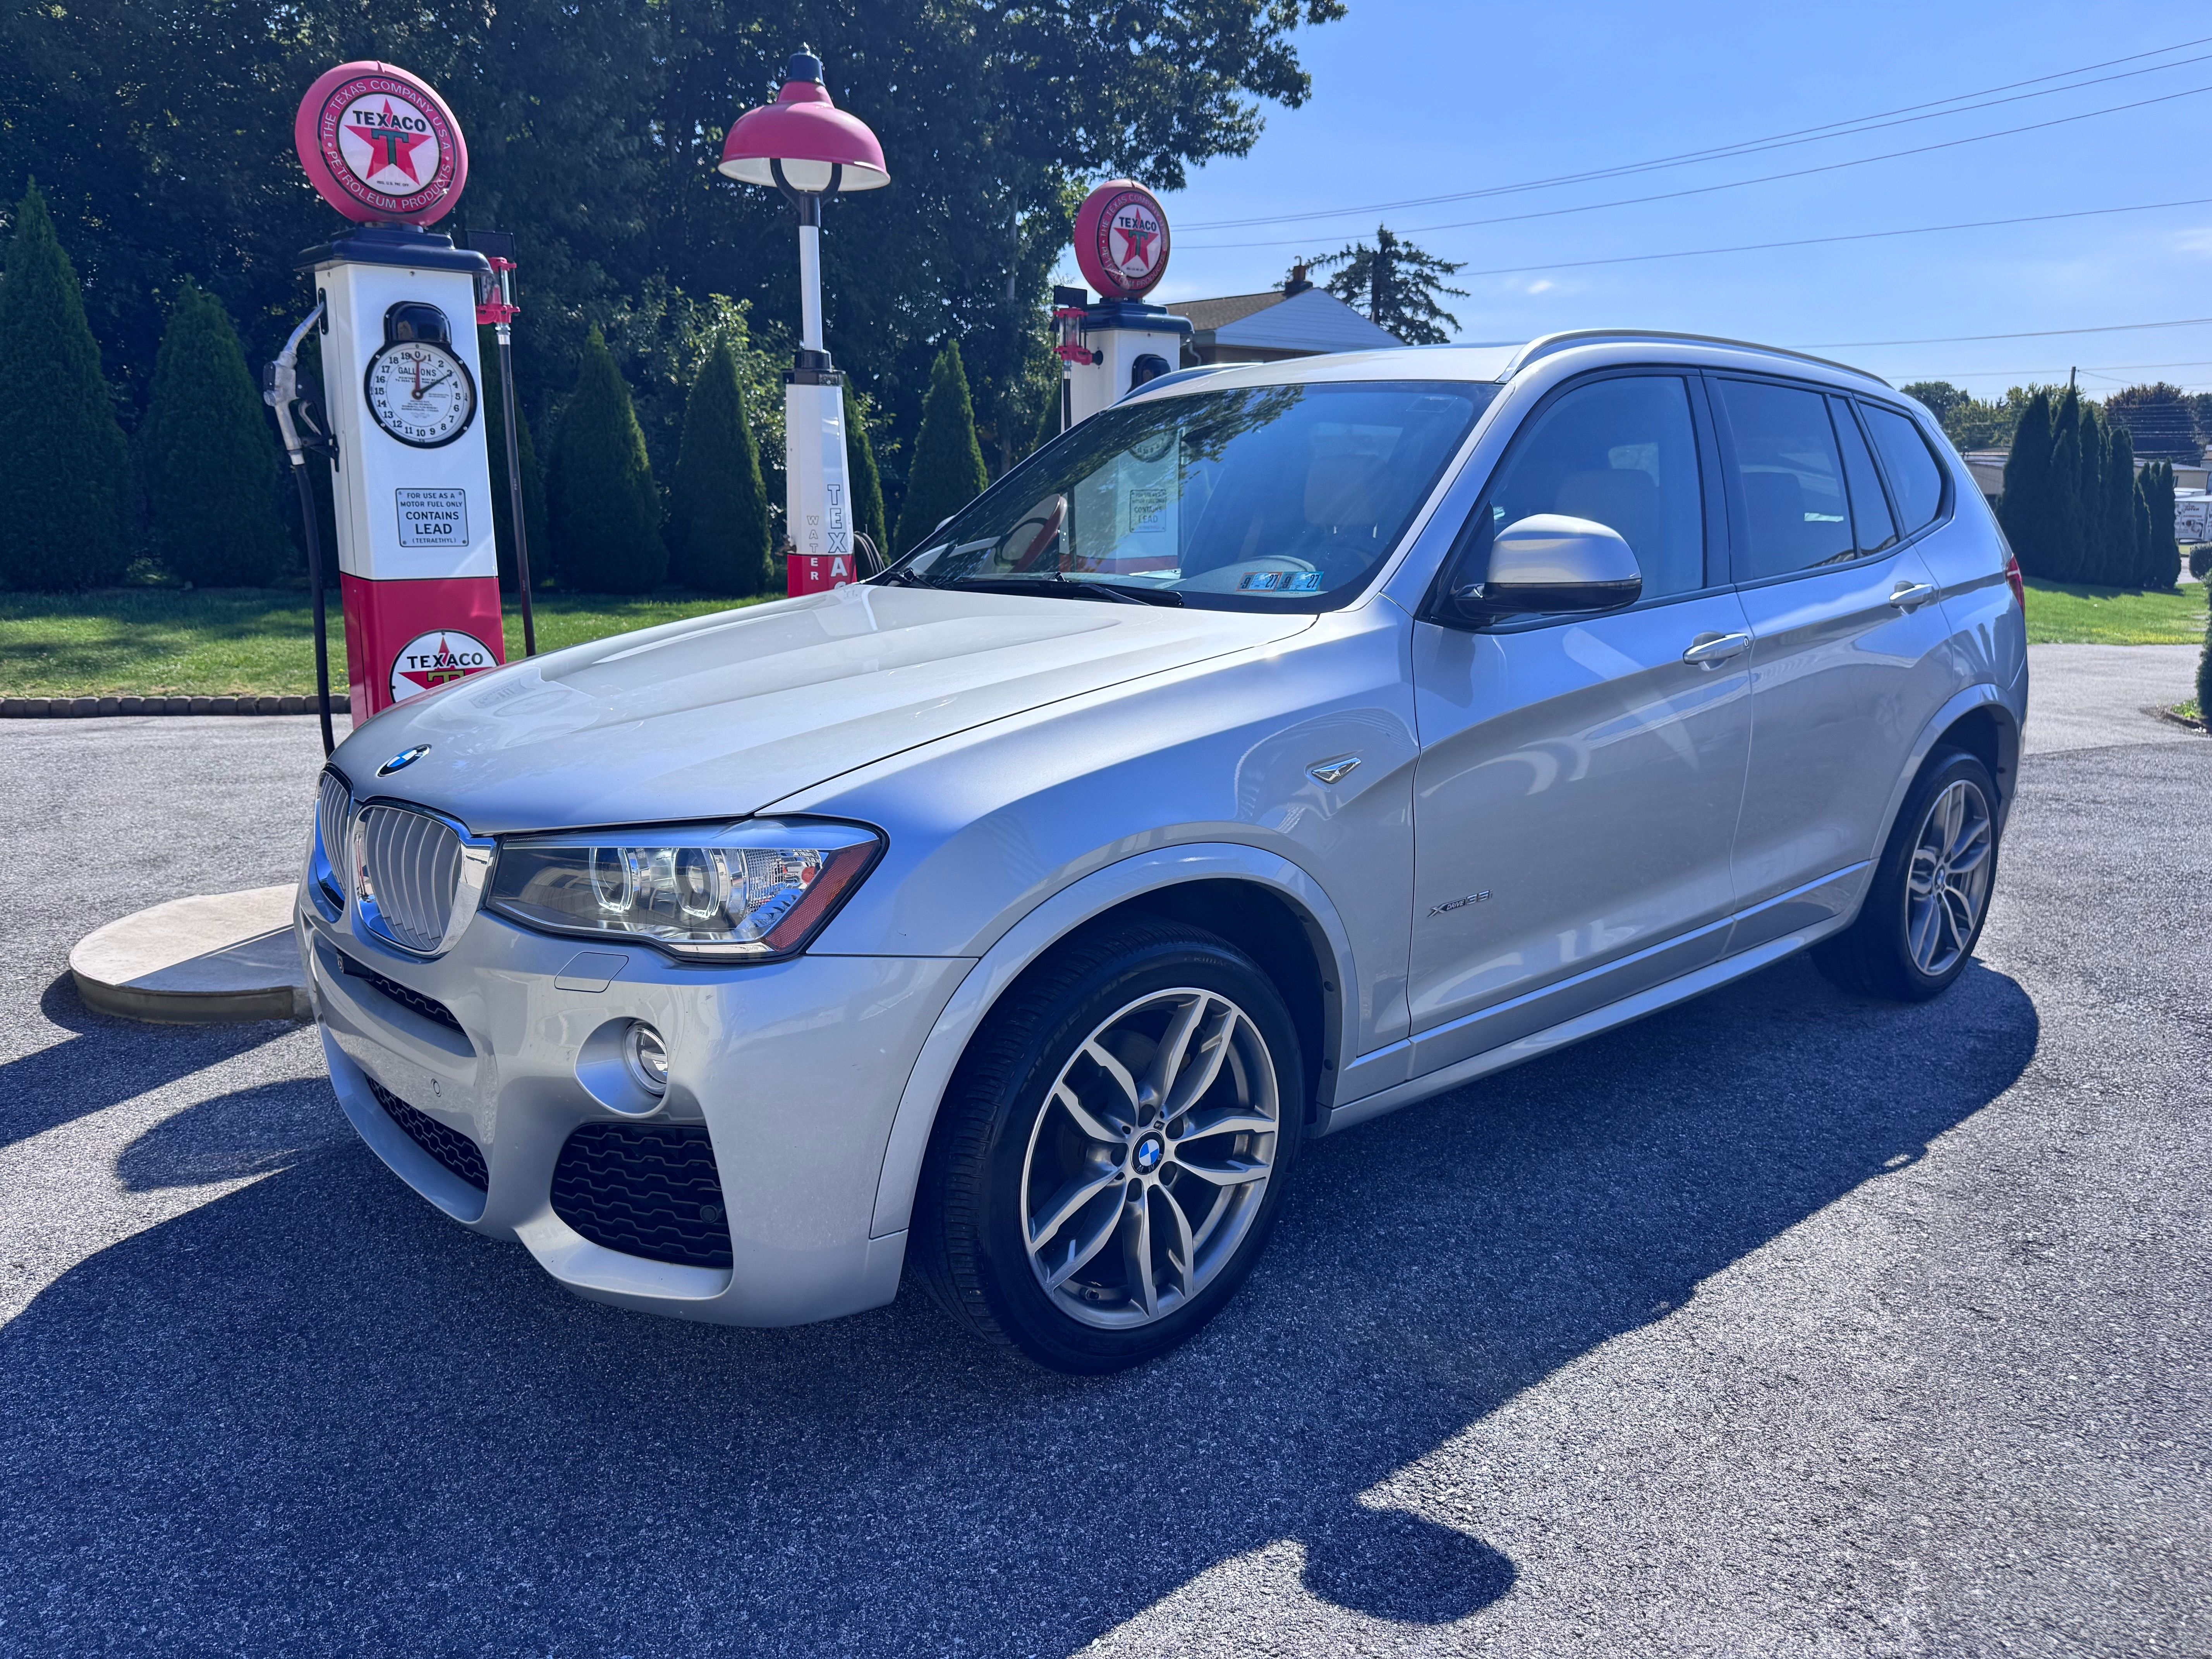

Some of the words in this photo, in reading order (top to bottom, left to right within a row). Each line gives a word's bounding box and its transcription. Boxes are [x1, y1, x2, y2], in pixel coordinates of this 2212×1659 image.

[324, 112, 336, 139] THE
[330, 82, 366, 110] TEXAS
[371, 80, 433, 113] COMPANY
[353, 110, 426, 132] TEXACO
[371, 128, 409, 166] T
[328, 151, 396, 209] PETROLEUM
[401, 164, 451, 209] PRODUCTS
[1101, 220, 1109, 236] THE
[1107, 196, 1127, 216] TEXAS
[1119, 216, 1157, 232] TEXACO
[1128, 230, 1149, 256] T
[398, 367, 437, 376] GALLONS
[406, 511, 459, 520] CONTAINS
[415, 523, 452, 534] LEAD
[807, 515, 819, 580] WATER
[1265, 574, 1279, 589] 27
[1306, 574, 1321, 588] 27
[407, 652, 484, 669] TEXACO
